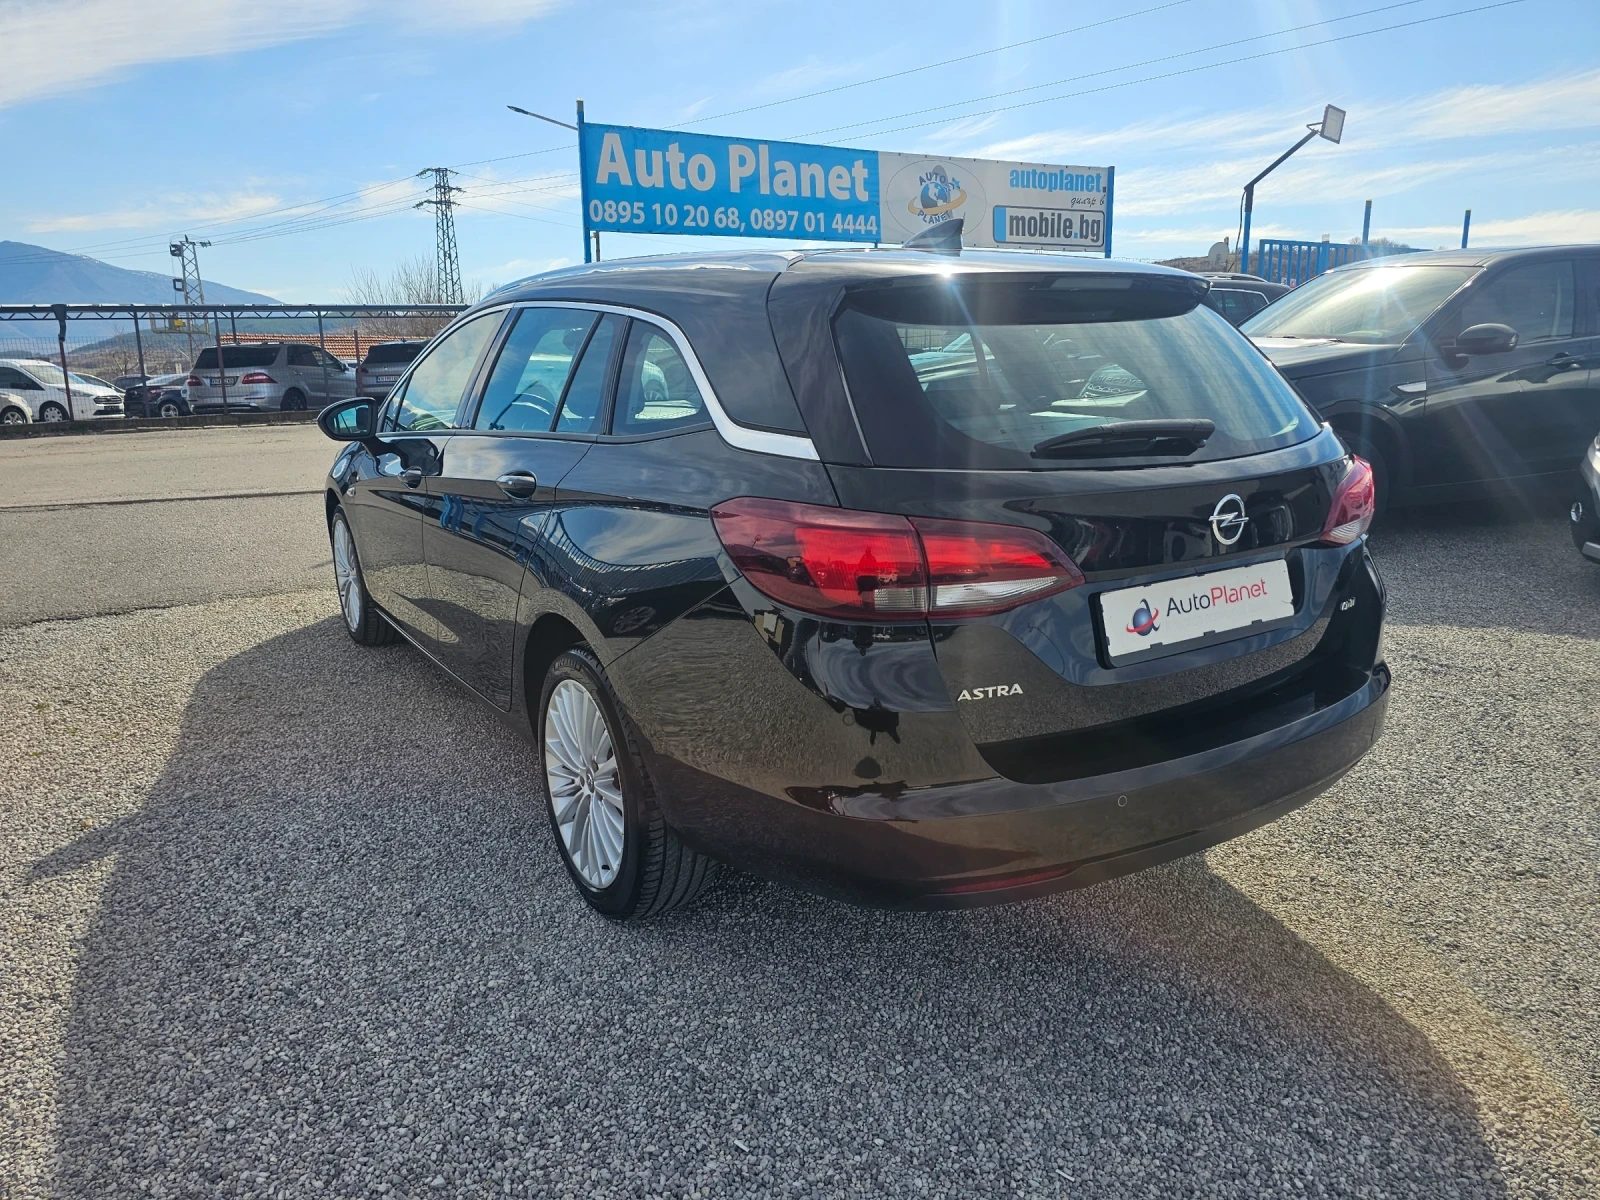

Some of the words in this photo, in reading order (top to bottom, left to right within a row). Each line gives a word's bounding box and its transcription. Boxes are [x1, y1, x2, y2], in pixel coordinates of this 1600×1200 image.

[596, 132, 716, 192] Auto
[728, 144, 869, 202] Planet
[919, 172, 946, 186] AUTO
[589, 199, 645, 225] 0895
[652, 203, 678, 226] 10
[684, 205, 709, 228] 20
[714, 206, 746, 232] 68,
[750, 208, 799, 232] 0897
[804, 211, 825, 233] 01
[832, 213, 878, 235] 4444
[918, 210, 950, 224] PLANET
[1009, 211, 1101, 243] mobile.bg
[1166, 579, 1267, 617] AutoPlanet
[957, 683, 1024, 702] ASTRA
